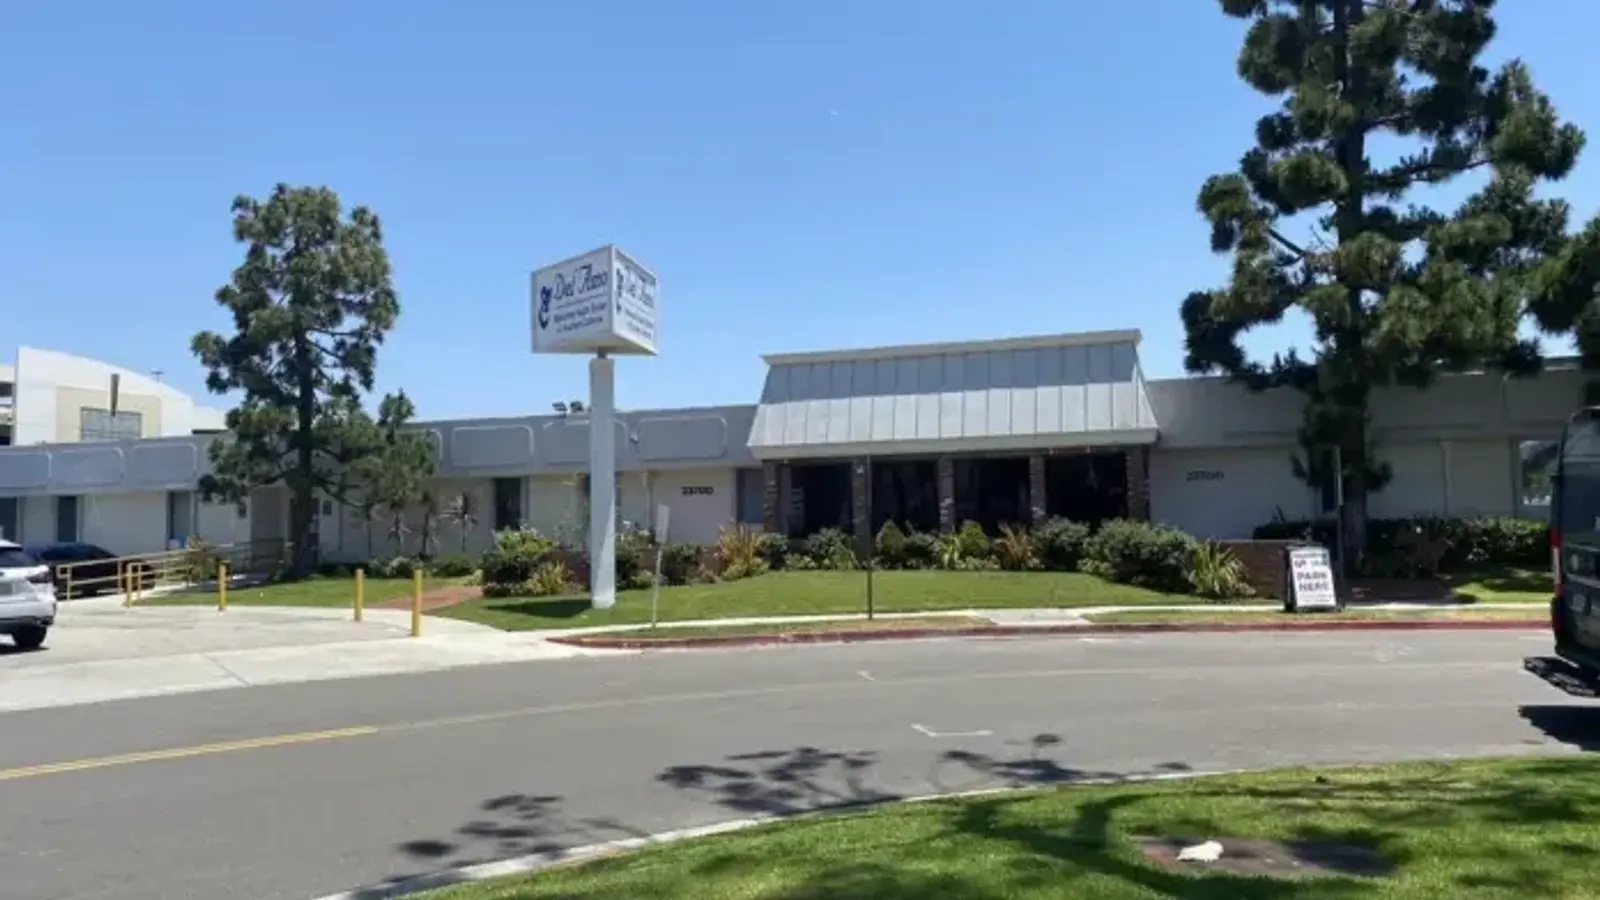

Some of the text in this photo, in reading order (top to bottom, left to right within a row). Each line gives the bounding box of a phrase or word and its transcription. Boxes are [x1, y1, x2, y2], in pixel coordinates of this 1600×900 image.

[554, 268, 578, 300] Del
[1296, 572, 1327, 581] PARK
[1299, 582, 1330, 592] HERE
